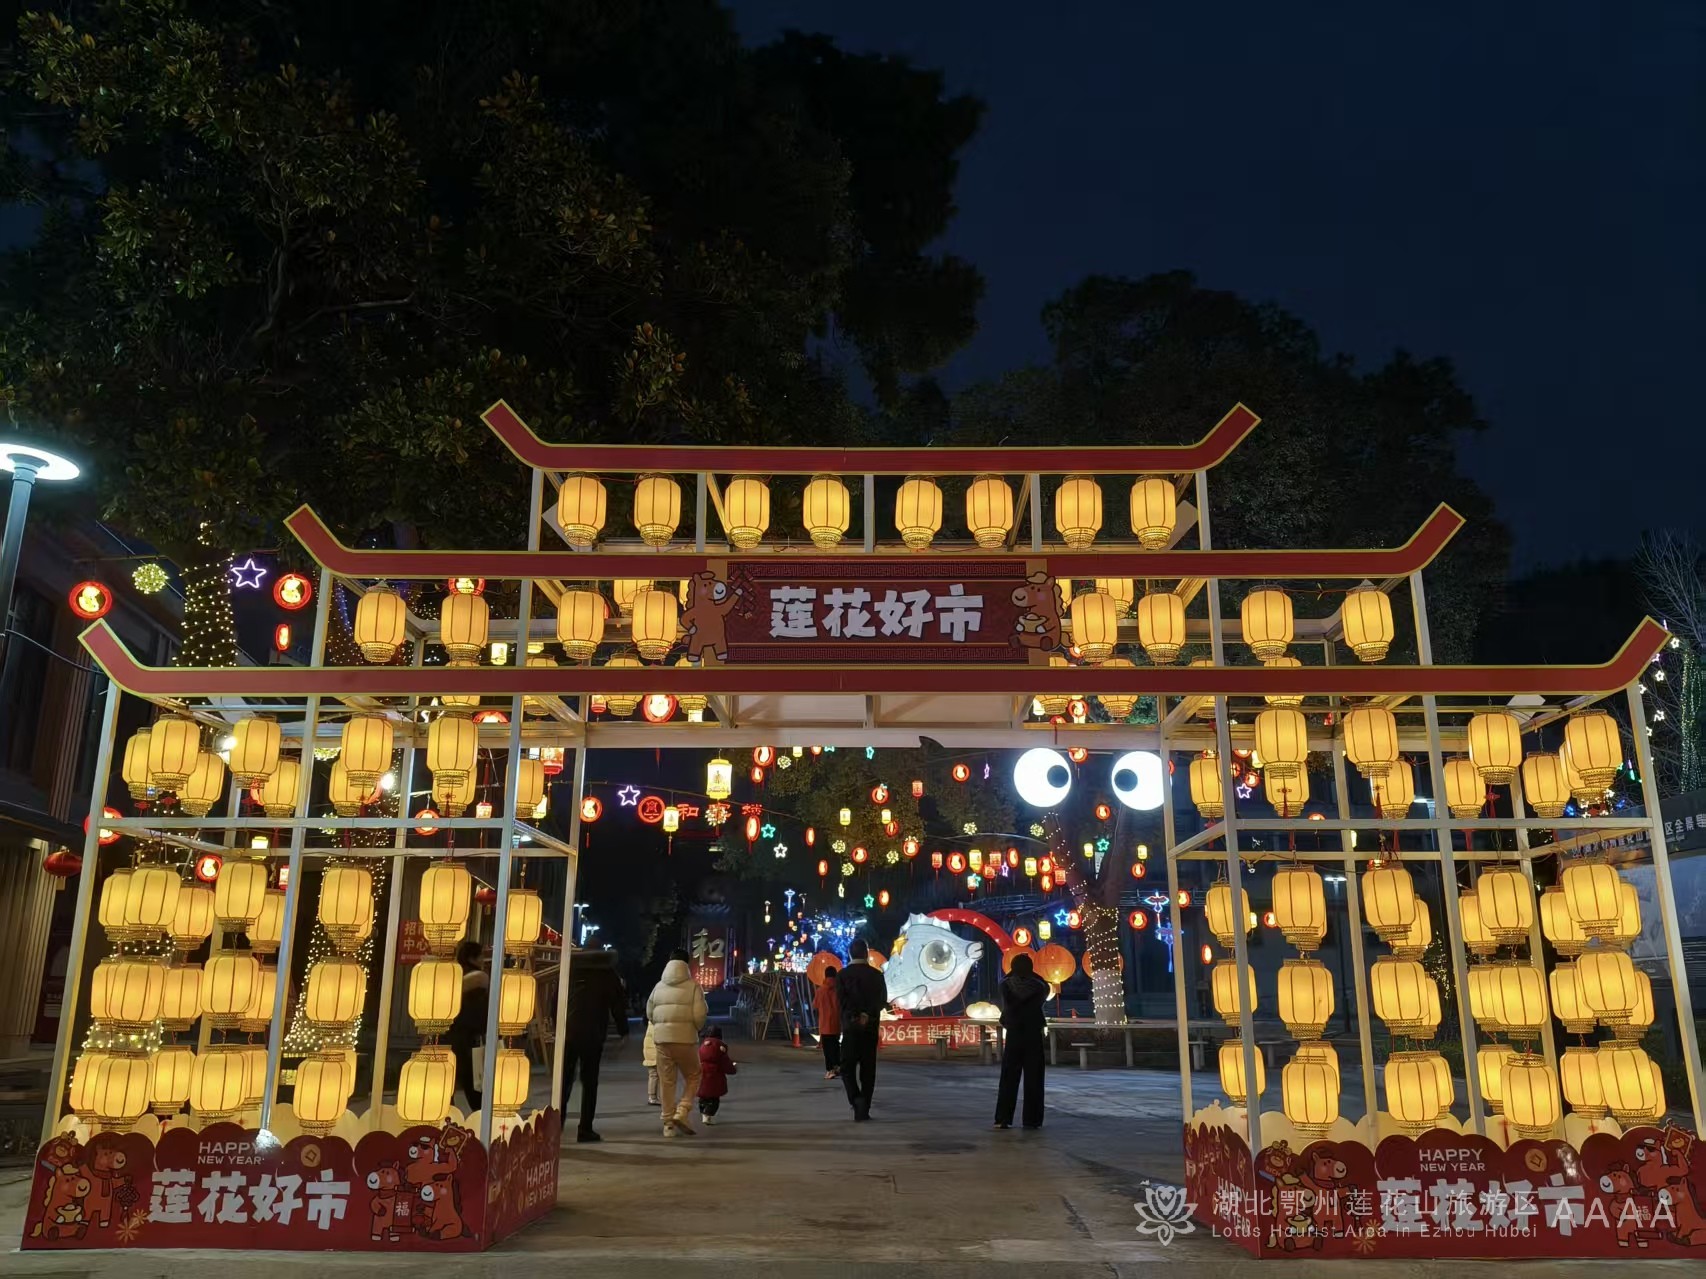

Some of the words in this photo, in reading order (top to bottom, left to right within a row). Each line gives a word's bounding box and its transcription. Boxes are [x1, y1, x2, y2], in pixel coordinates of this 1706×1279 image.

[769, 583, 985, 642] 莲花好市
[691, 927, 726, 966] 和
[198, 1141, 263, 1155] HAPPY
[1418, 1148, 1483, 1162] HAPPY
[197, 1155, 225, 1165] NEW
[229, 1155, 262, 1165] YEAR
[1420, 1163, 1446, 1172] NEW
[1450, 1162, 1486, 1172] YEAR
[526, 1158, 556, 1189] HAPPY
[147, 1167, 351, 1231] 莲花好市
[395, 1201, 410, 1217] 福
[1374, 1173, 1586, 1239] 莲花好市
